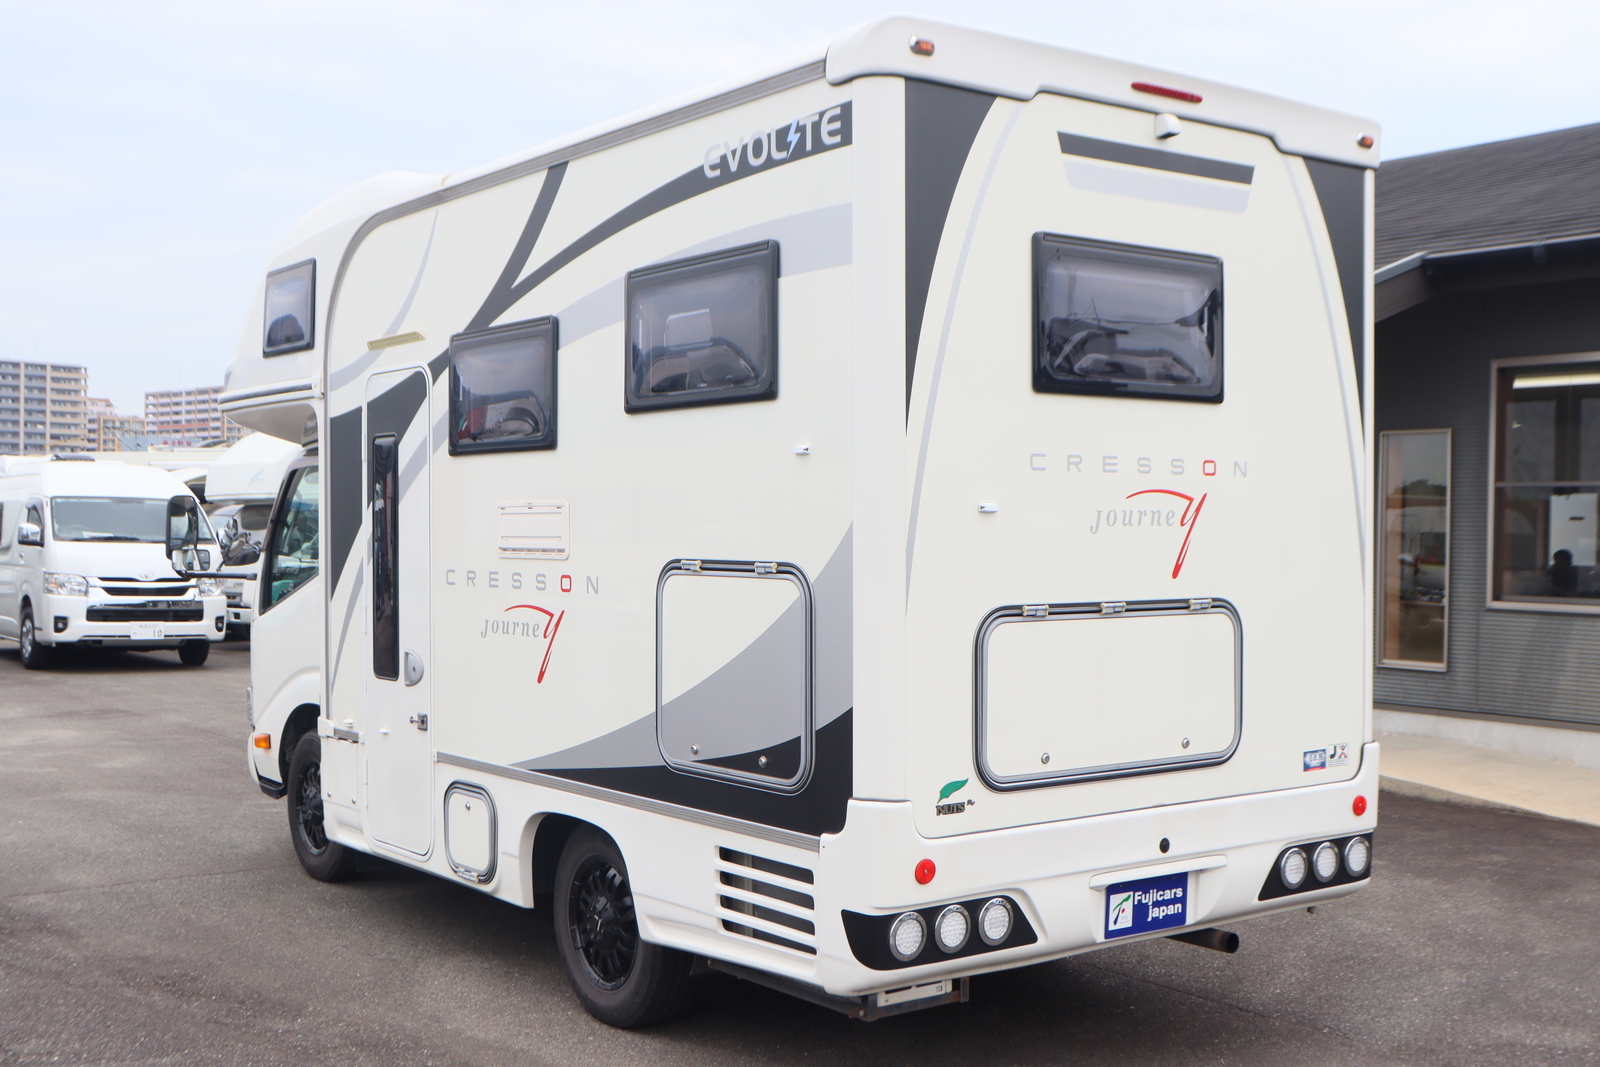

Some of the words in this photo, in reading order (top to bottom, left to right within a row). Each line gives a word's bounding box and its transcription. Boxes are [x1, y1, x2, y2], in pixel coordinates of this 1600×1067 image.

[1029, 452, 1249, 478] CRESSON
[445, 568, 599, 595] CRESSON
[936, 801, 966, 817] NUTS
[1134, 887, 1184, 906] Fujicars
[1146, 903, 1183, 922] japan
